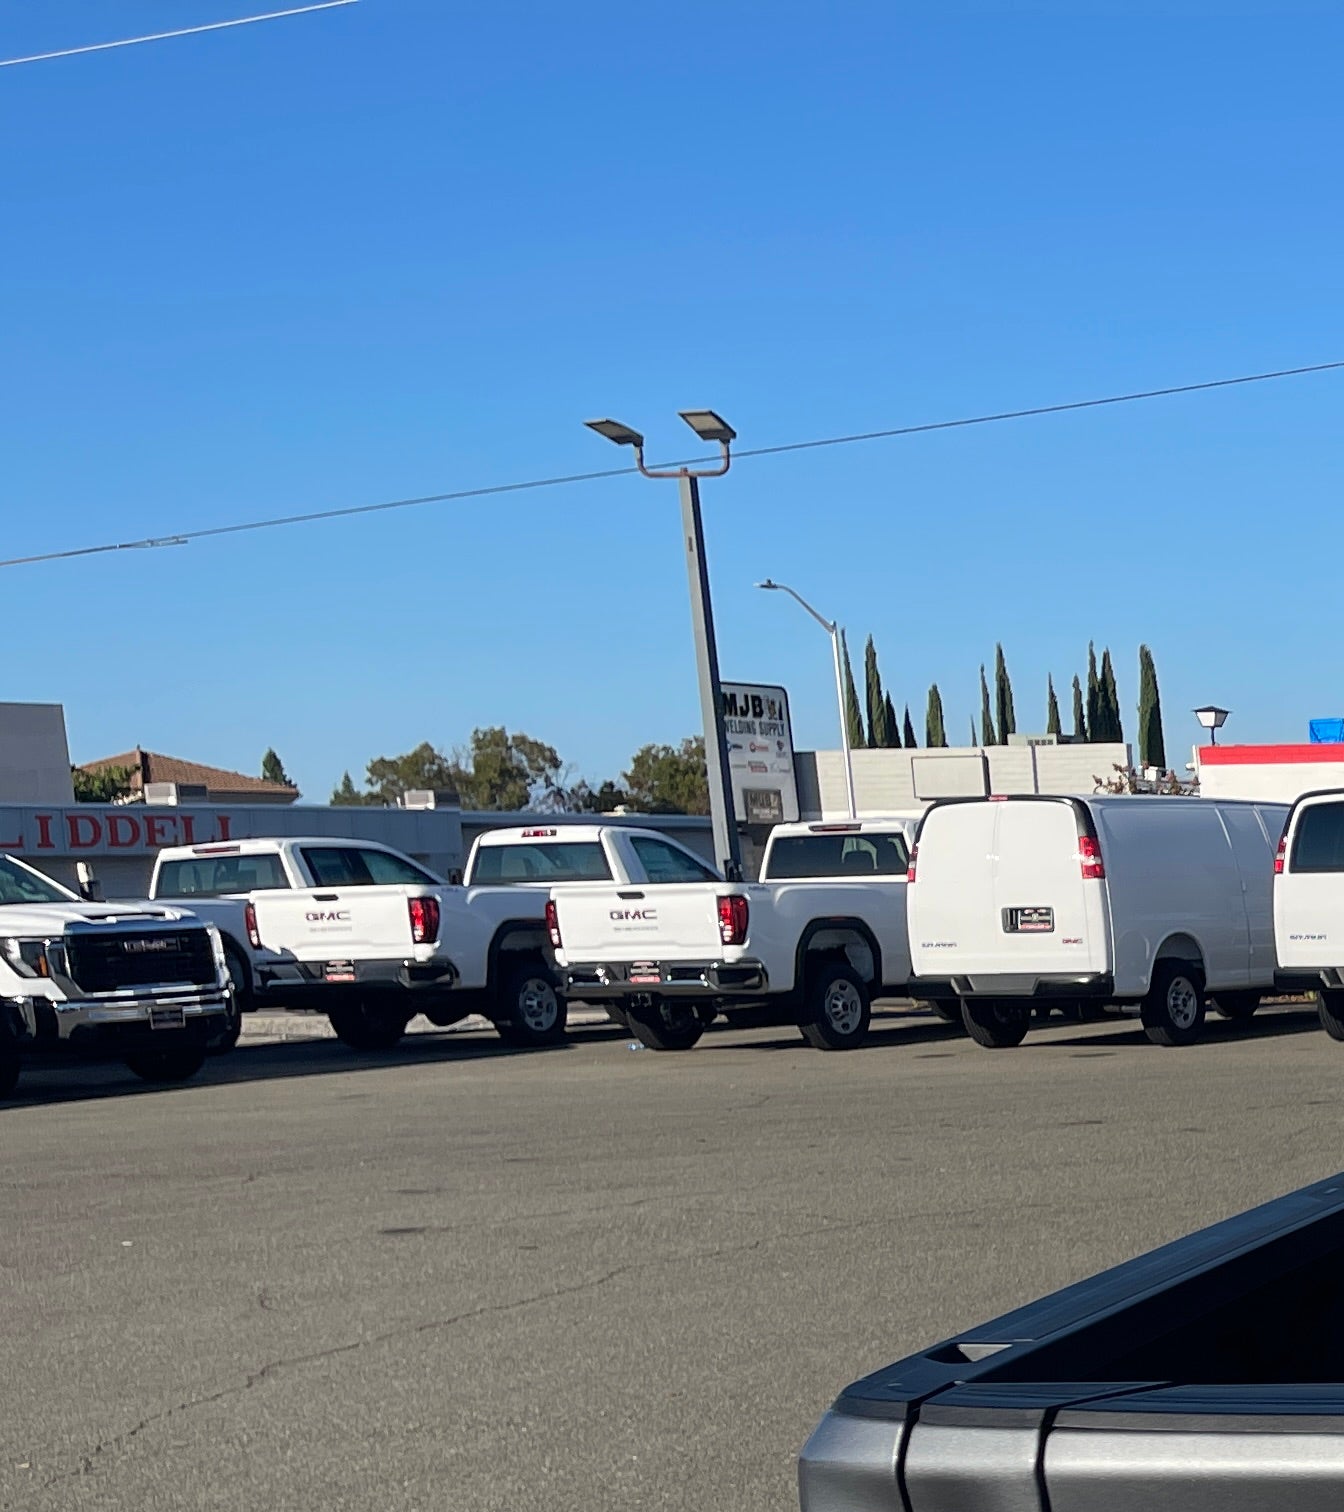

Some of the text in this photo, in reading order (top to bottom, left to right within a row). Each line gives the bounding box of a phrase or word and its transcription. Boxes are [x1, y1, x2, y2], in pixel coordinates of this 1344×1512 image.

[722, 692, 764, 718] MJB
[759, 722, 785, 737] SUPPLY
[609, 909, 658, 920] GMC
